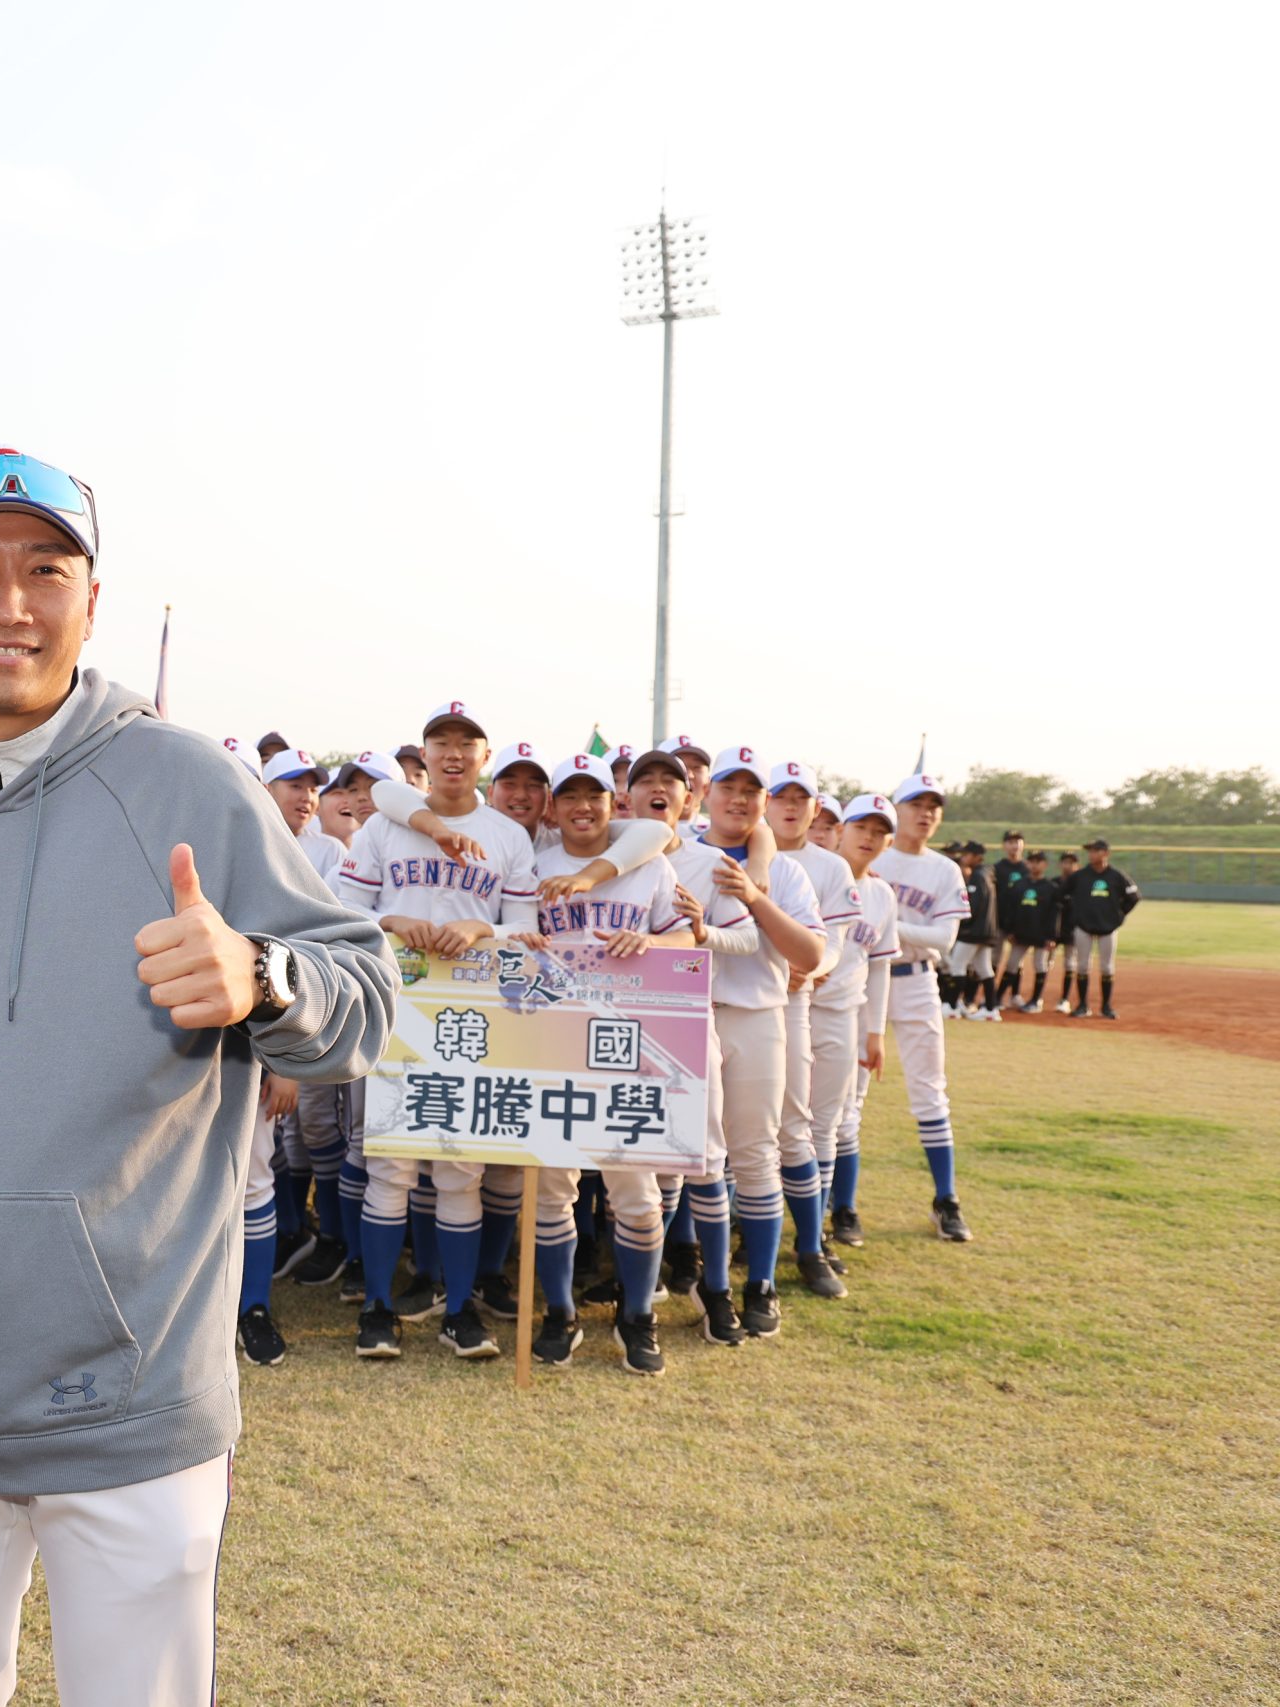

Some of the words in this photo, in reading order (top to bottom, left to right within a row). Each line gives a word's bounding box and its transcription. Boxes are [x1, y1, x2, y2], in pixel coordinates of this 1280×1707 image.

[389, 857, 502, 900] CENTUM
[434, 1006, 641, 1072] 韓國
[405, 1071, 667, 1144] 賽騰中學
[43, 1407, 70, 1417] UNDER
[72, 1402, 108, 1414] ARMOUR
